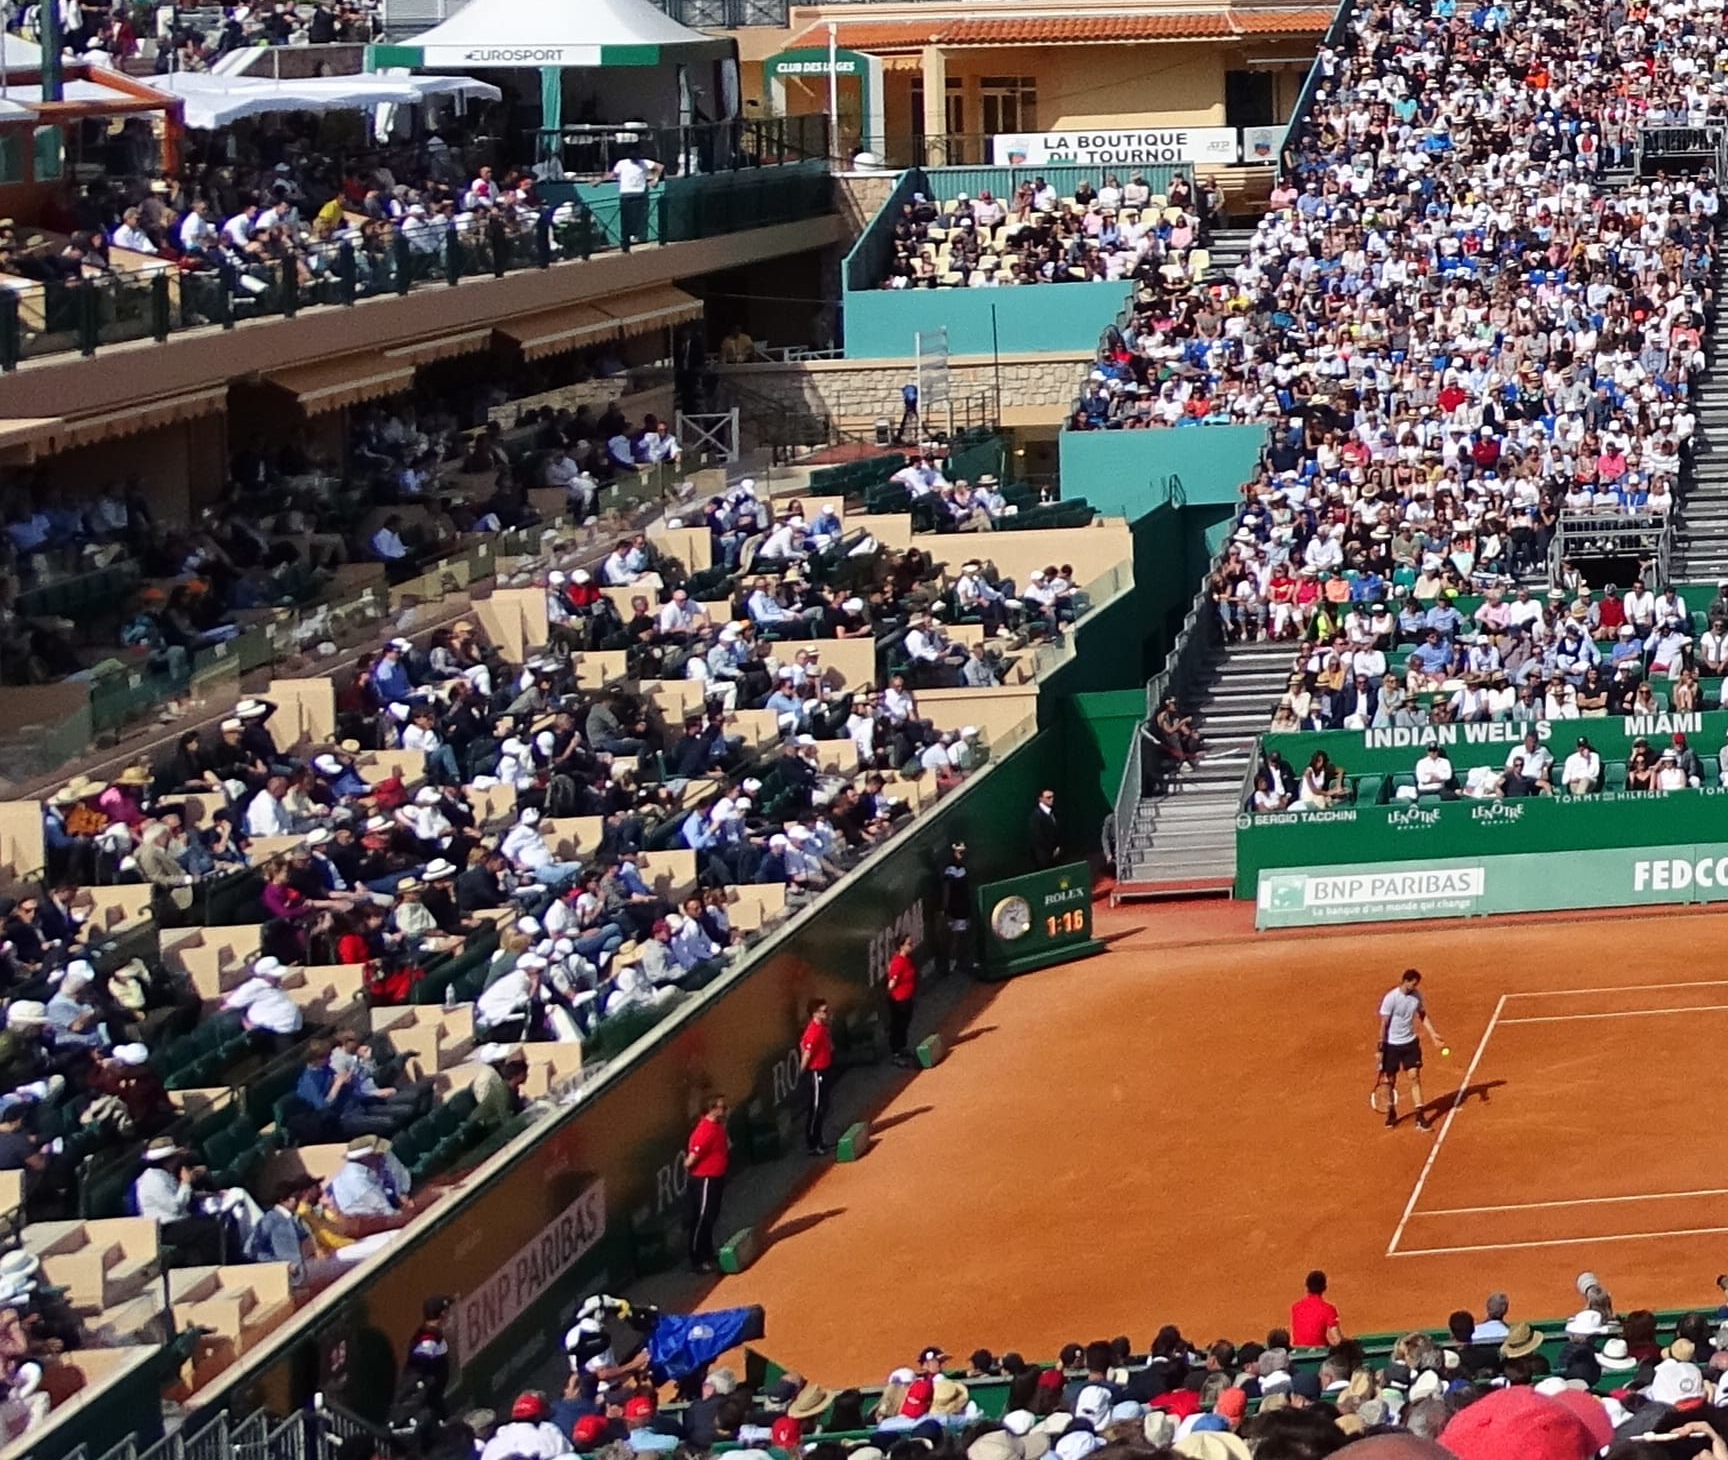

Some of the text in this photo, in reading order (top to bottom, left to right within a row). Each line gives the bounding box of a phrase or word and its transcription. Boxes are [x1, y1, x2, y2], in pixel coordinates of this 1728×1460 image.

[470, 49, 564, 61] EUROSPORT
[1043, 133, 1189, 150] LA BOUTIQUE
[1088, 148, 1183, 164] TOURNOI
[1625, 711, 1702, 735] MIAMI
[1365, 720, 1552, 749] INDIAN WELLS
[1555, 790, 1669, 804] TOMMY HILFIGER
[1255, 810, 1357, 825] SERGIO TACCHINI
[1314, 872, 1472, 901] BNP PARIBAS
[1044, 887, 1085, 906] ROLEX
[1326, 905, 1361, 917] banque
[1362, 903, 1384, 914] d'un
[1386, 901, 1418, 912] monde
[1420, 899, 1436, 911] qui
[1437, 898, 1472, 911] change
[1046, 908, 1084, 937] 1:16
[515, 1192, 598, 1308] PARIBAS
